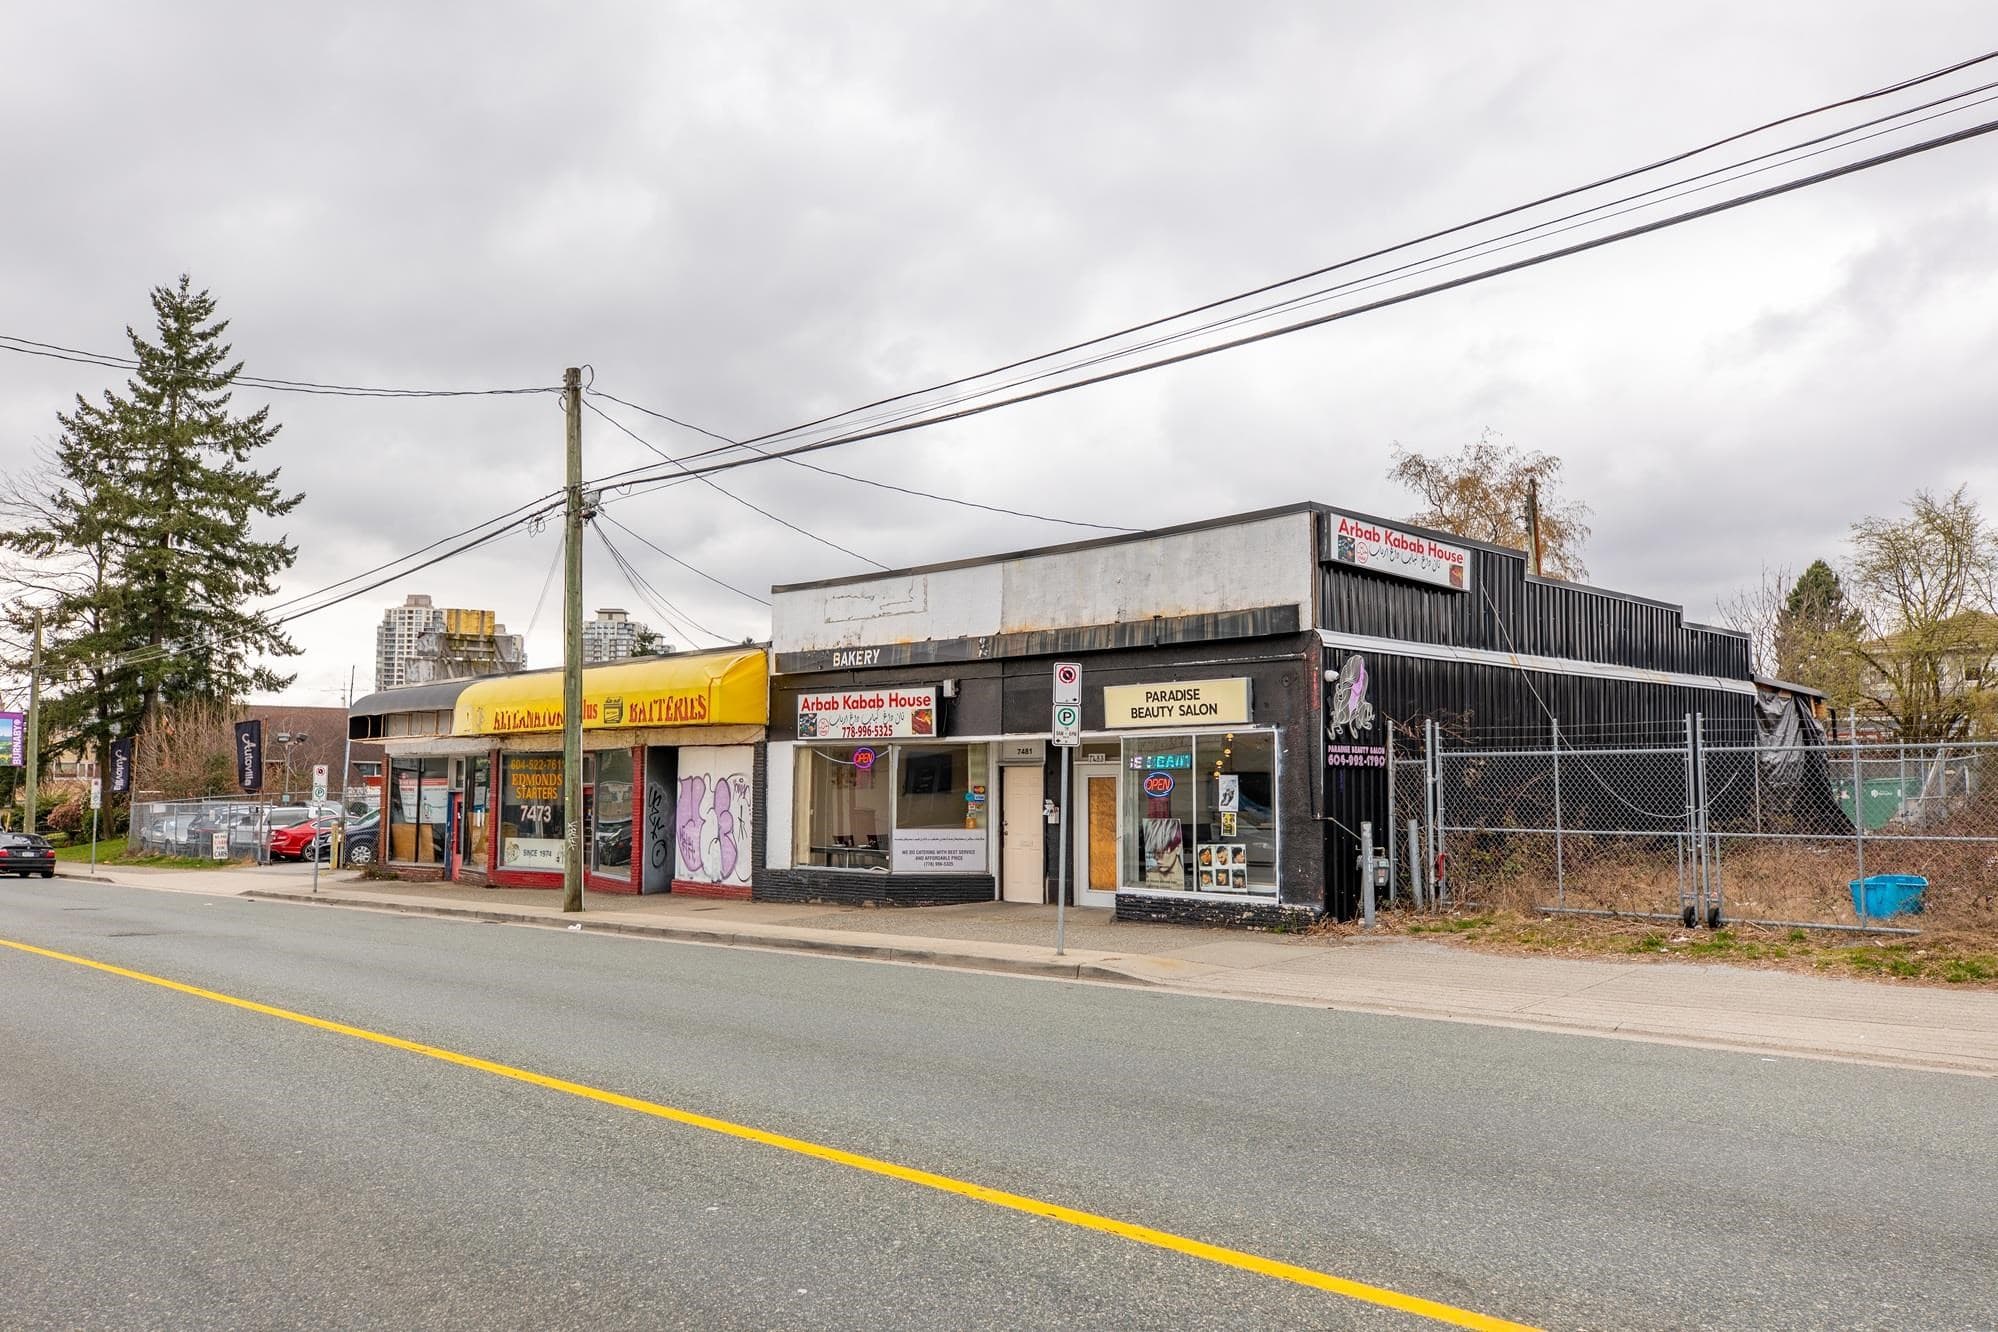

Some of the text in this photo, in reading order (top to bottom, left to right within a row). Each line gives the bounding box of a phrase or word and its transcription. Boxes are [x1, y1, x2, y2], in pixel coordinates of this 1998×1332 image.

[1338, 518, 1380, 542] Arbab
[1385, 530, 1424, 554] Kabab
[1428, 544, 1464, 564] House
[833, 648, 880, 667] BAKERY
[801, 692, 932, 712] Arbab Kabab House
[1145, 688, 1200, 703] PARADISE
[583, 699, 598, 720] lus
[1131, 703, 1218, 719] BEAUTY SALON
[842, 725, 893, 737] 778-996-5325
[12, 725, 22, 765] BURNABY
[1328, 745, 1385, 755] PARADISE BEAUTY SALON
[242, 733, 256, 786] Autovilla
[856, 752, 873, 763] OPEN
[114, 749, 127, 791] Autovilla
[511, 773, 563, 786] EDMONDS
[1146, 778, 1172, 791] OPEN
[515, 787, 558, 800] STARTERS
[520, 805, 552, 822] 7473
[523, 849, 538, 857] SINCE
